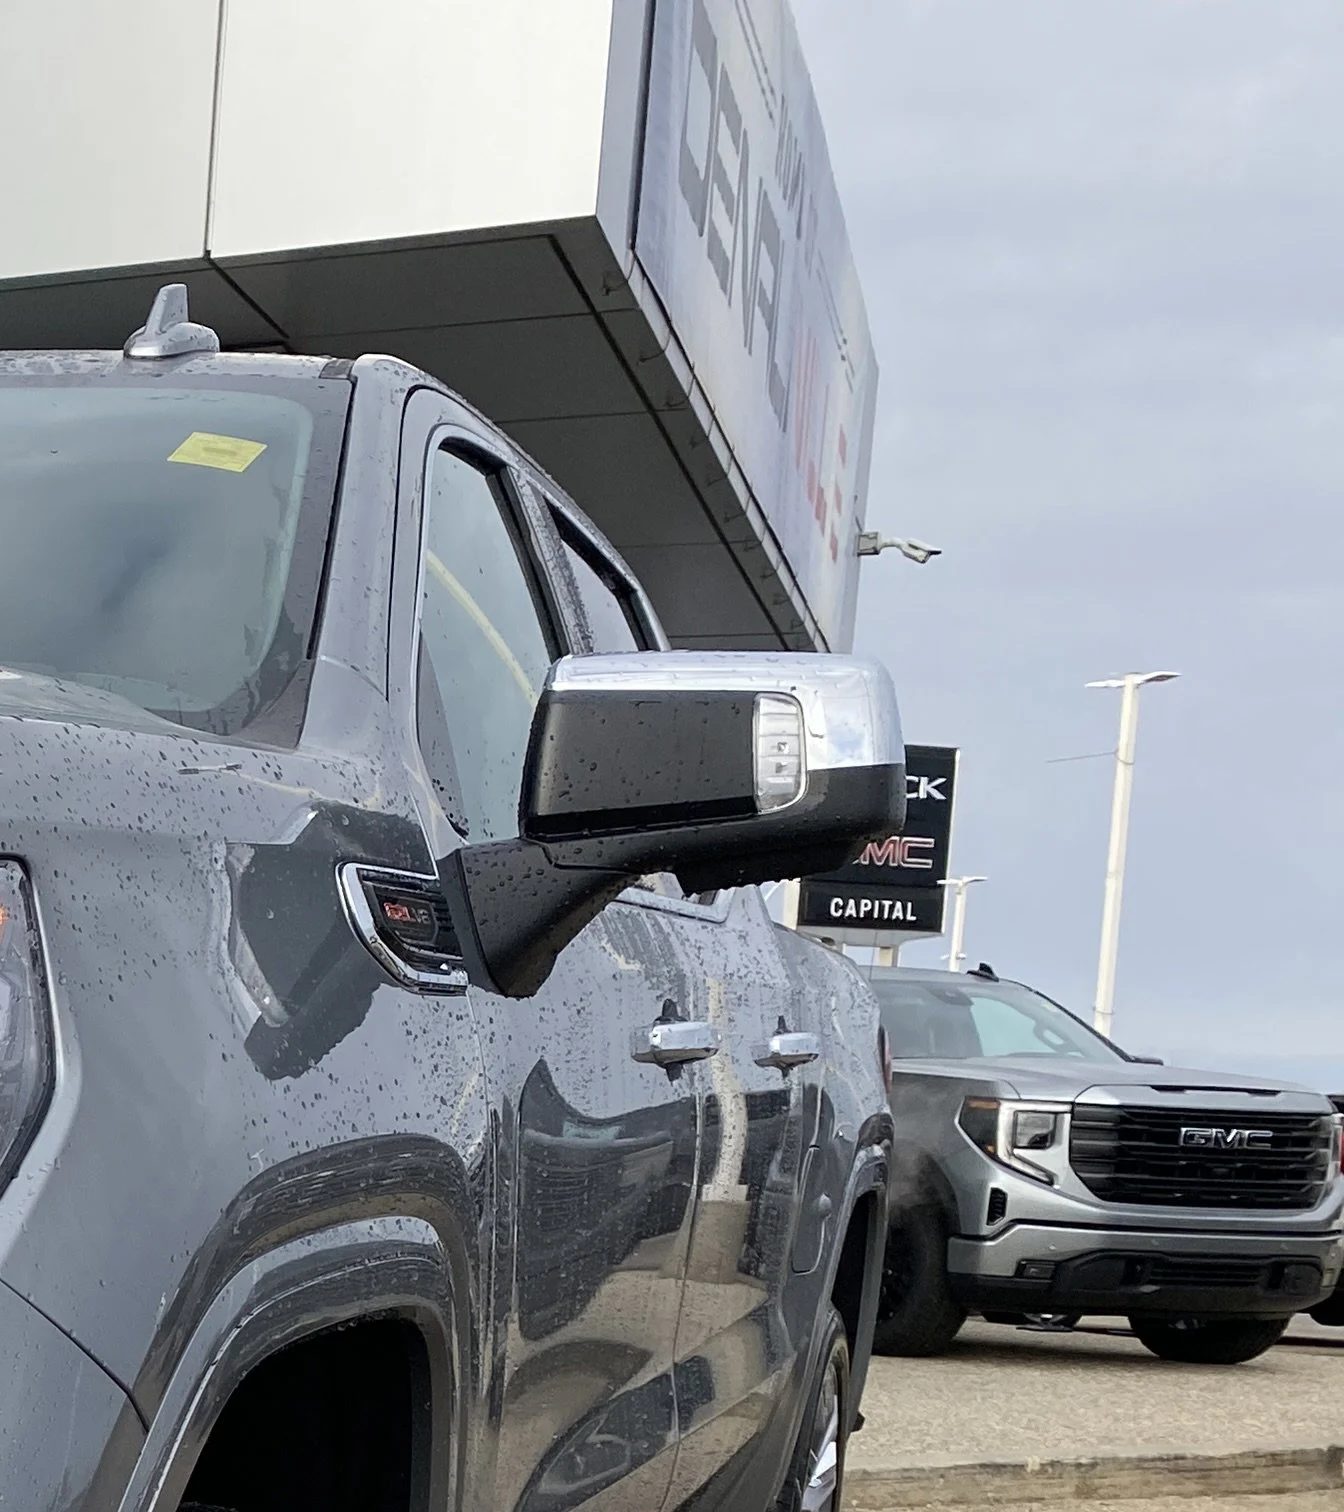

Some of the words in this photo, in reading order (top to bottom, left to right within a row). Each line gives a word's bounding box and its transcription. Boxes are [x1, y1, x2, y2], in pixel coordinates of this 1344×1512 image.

[853, 836, 935, 868] MC
[830, 897, 917, 921] CAPITAL
[1179, 1127, 1273, 1150] GMC
